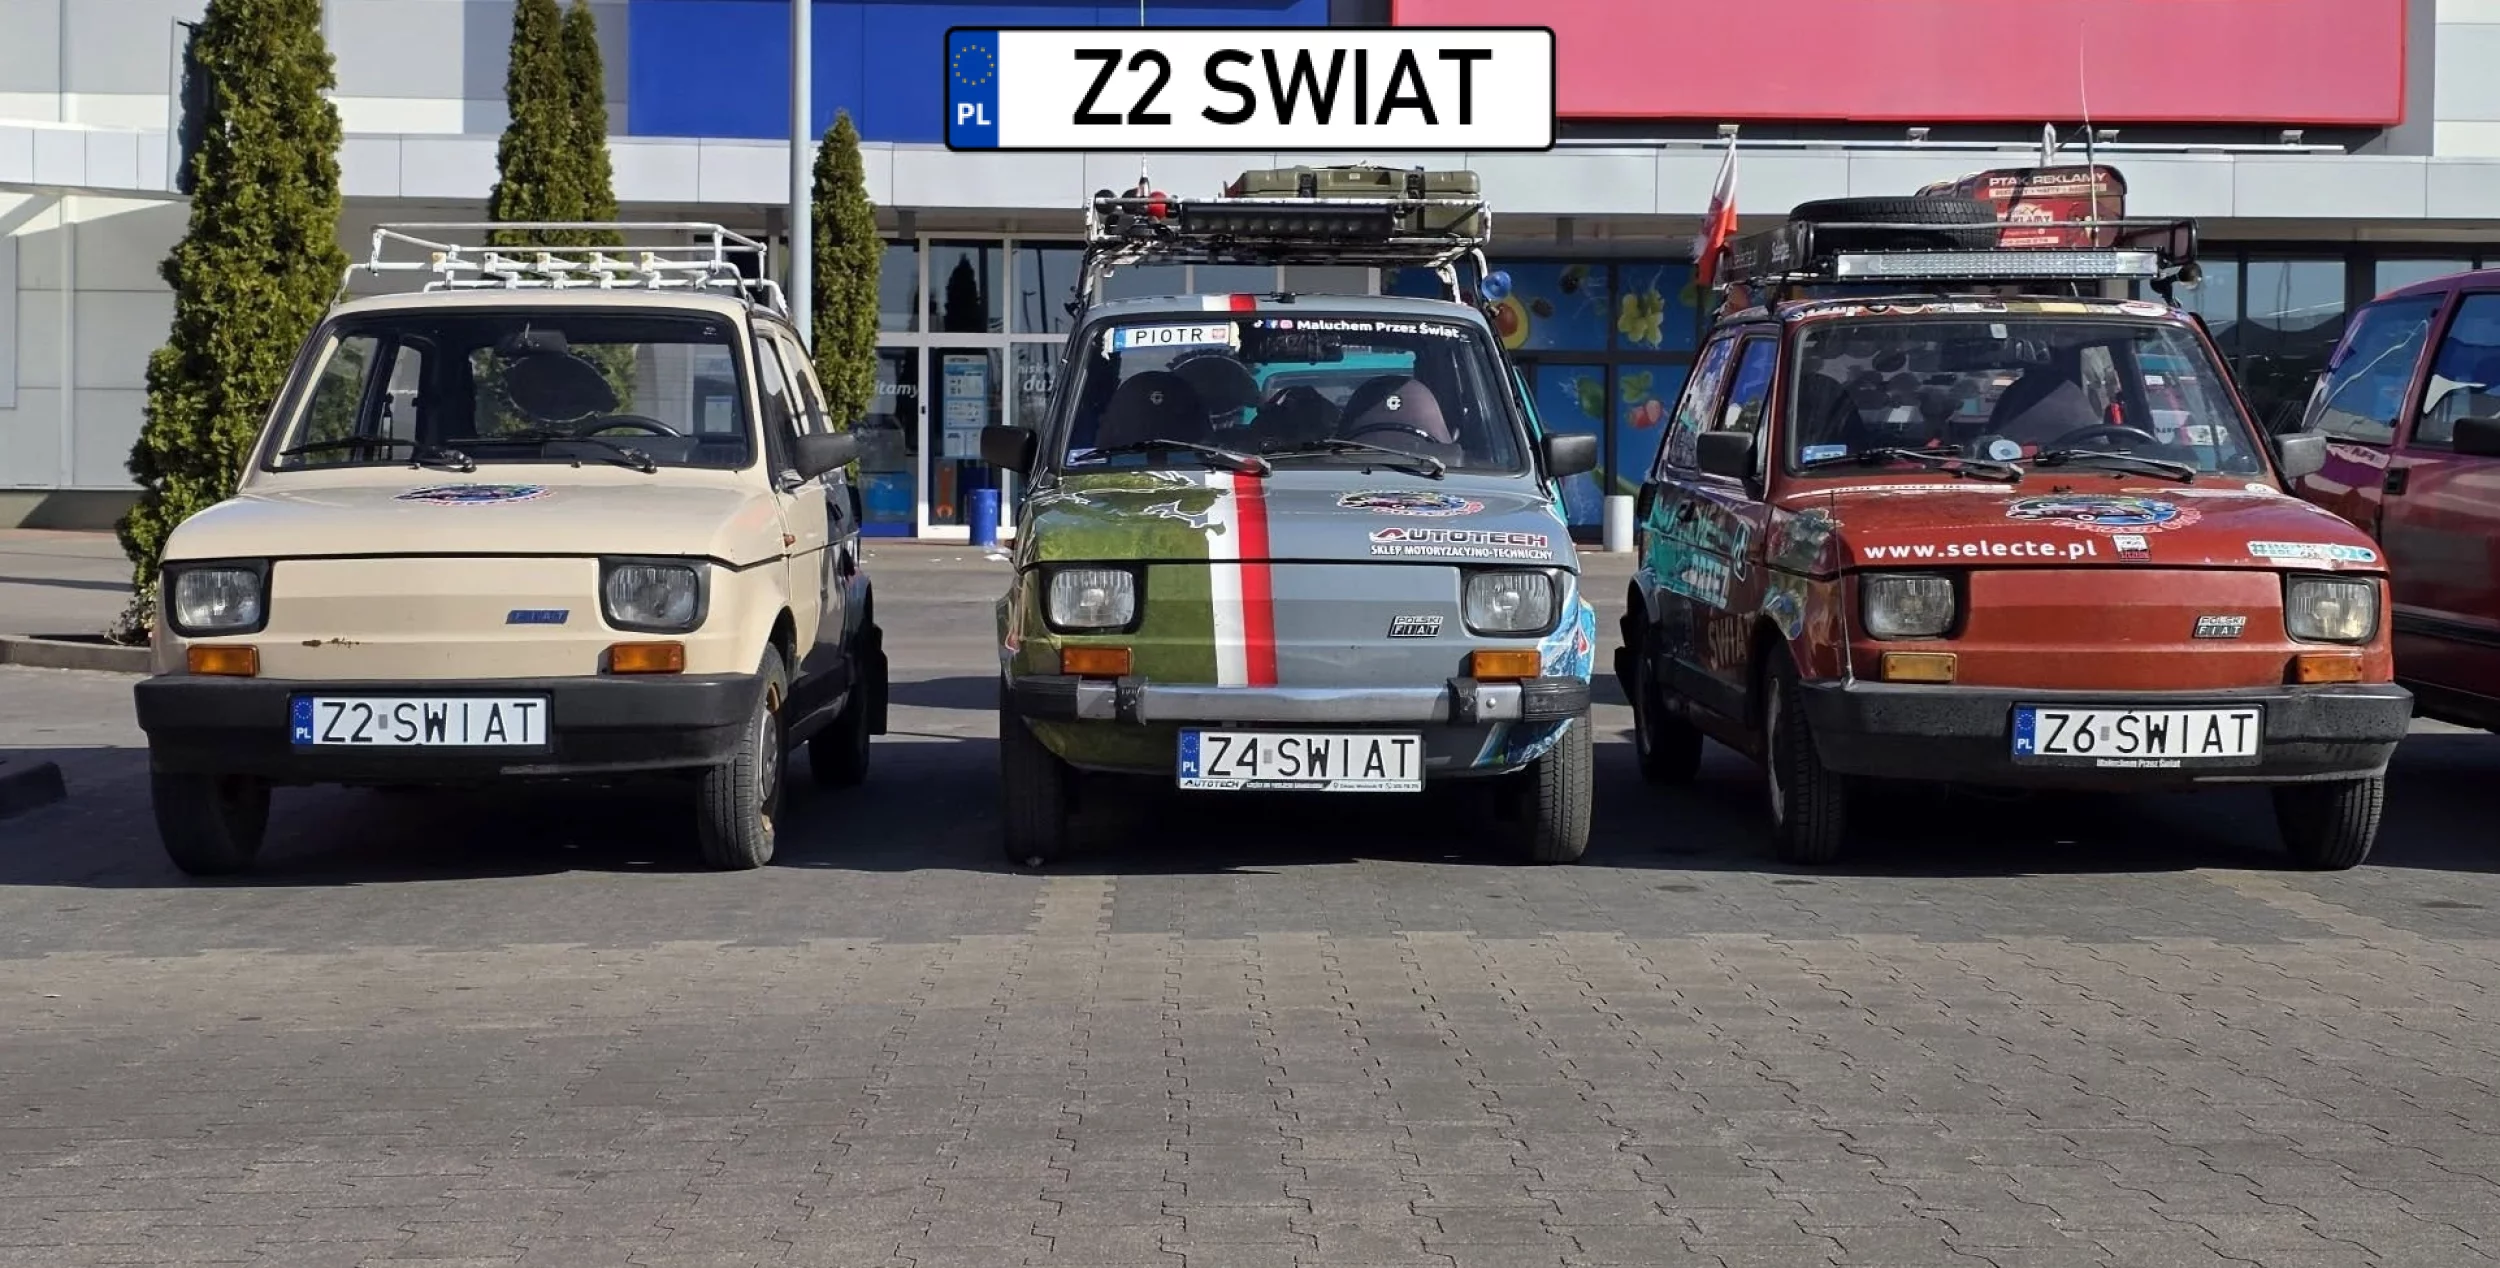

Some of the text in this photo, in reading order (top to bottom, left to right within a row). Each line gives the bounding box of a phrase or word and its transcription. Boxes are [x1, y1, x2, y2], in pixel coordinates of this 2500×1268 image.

[1989, 172, 2108, 187] PTAK REKLAMY
[1135, 327, 1204, 345] PIOTR
[1296, 320, 1460, 338] Maluchem Przez Świat
[874, 379, 918, 399] itamy
[1369, 527, 1548, 549] AUTOTECH
[1371, 544, 1553, 559] SKLEP MOTORYZACYJNO-TECHNICZNY
[1863, 539, 2097, 559] www.selecte.pl
[514, 611, 564, 621] FIAT
[1394, 625, 1439, 634] FIAT
[2199, 626, 2242, 635] FIAT
[321, 701, 538, 743] Z2 SWIAT
[295, 727, 311, 739] PL
[2043, 708, 2254, 754] Z6 ŚWIAT
[2017, 738, 2033, 750] PL
[1207, 736, 1416, 778] Z4 SWIAT
[1182, 761, 1198, 772] PL
[1184, 779, 1241, 788] AUTOTECH
